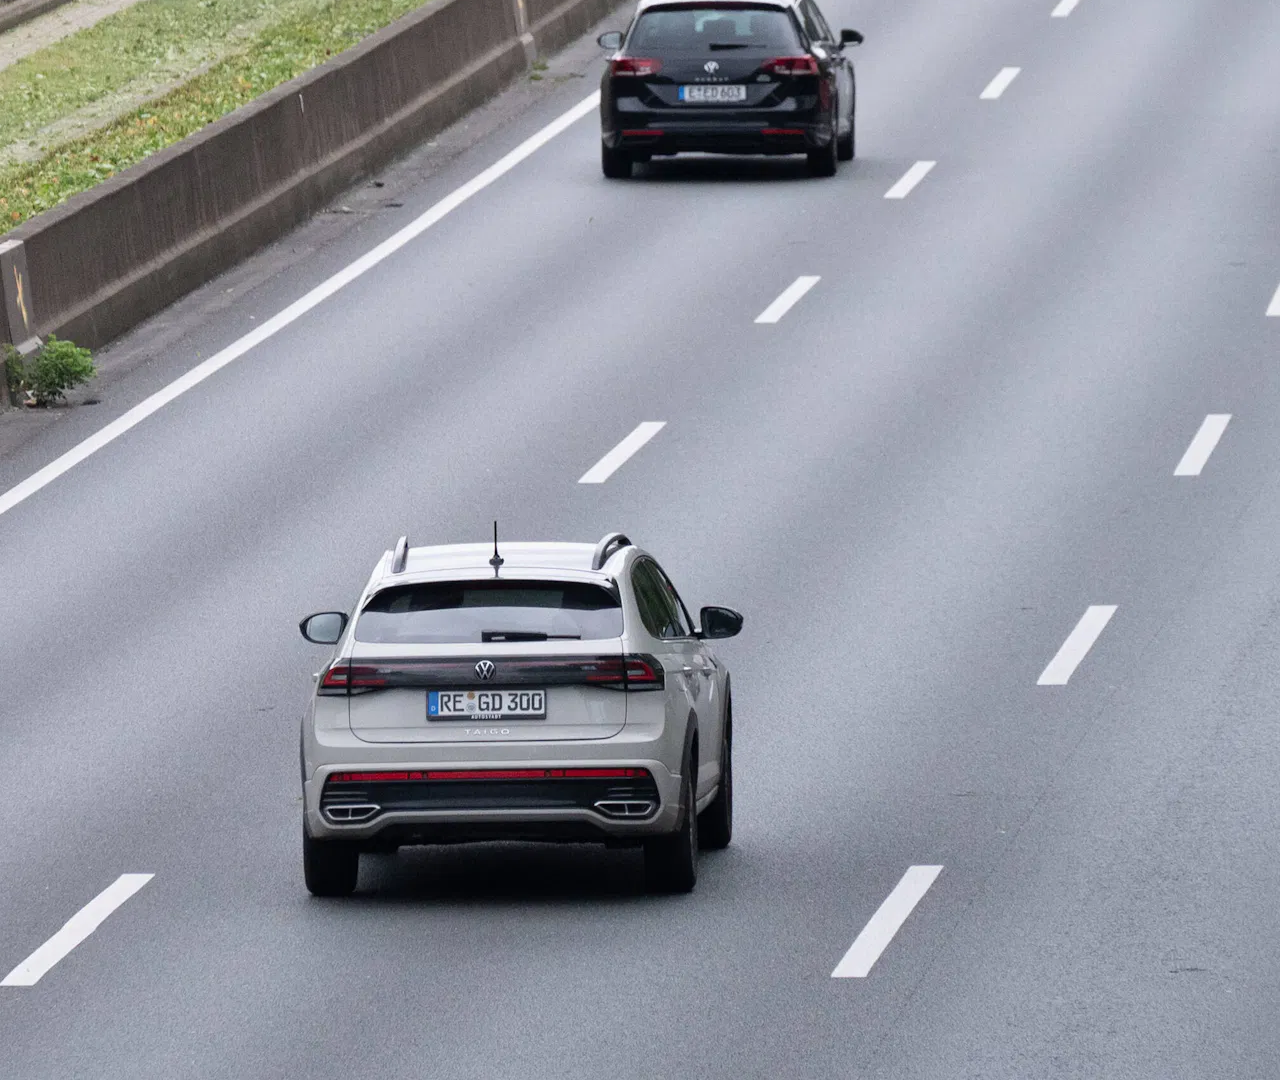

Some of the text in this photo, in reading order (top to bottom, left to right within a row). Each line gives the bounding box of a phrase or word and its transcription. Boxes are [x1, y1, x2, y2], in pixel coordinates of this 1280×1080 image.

[440, 694, 464, 712] RE
[478, 693, 502, 711] GD
[508, 692, 543, 711] 300
